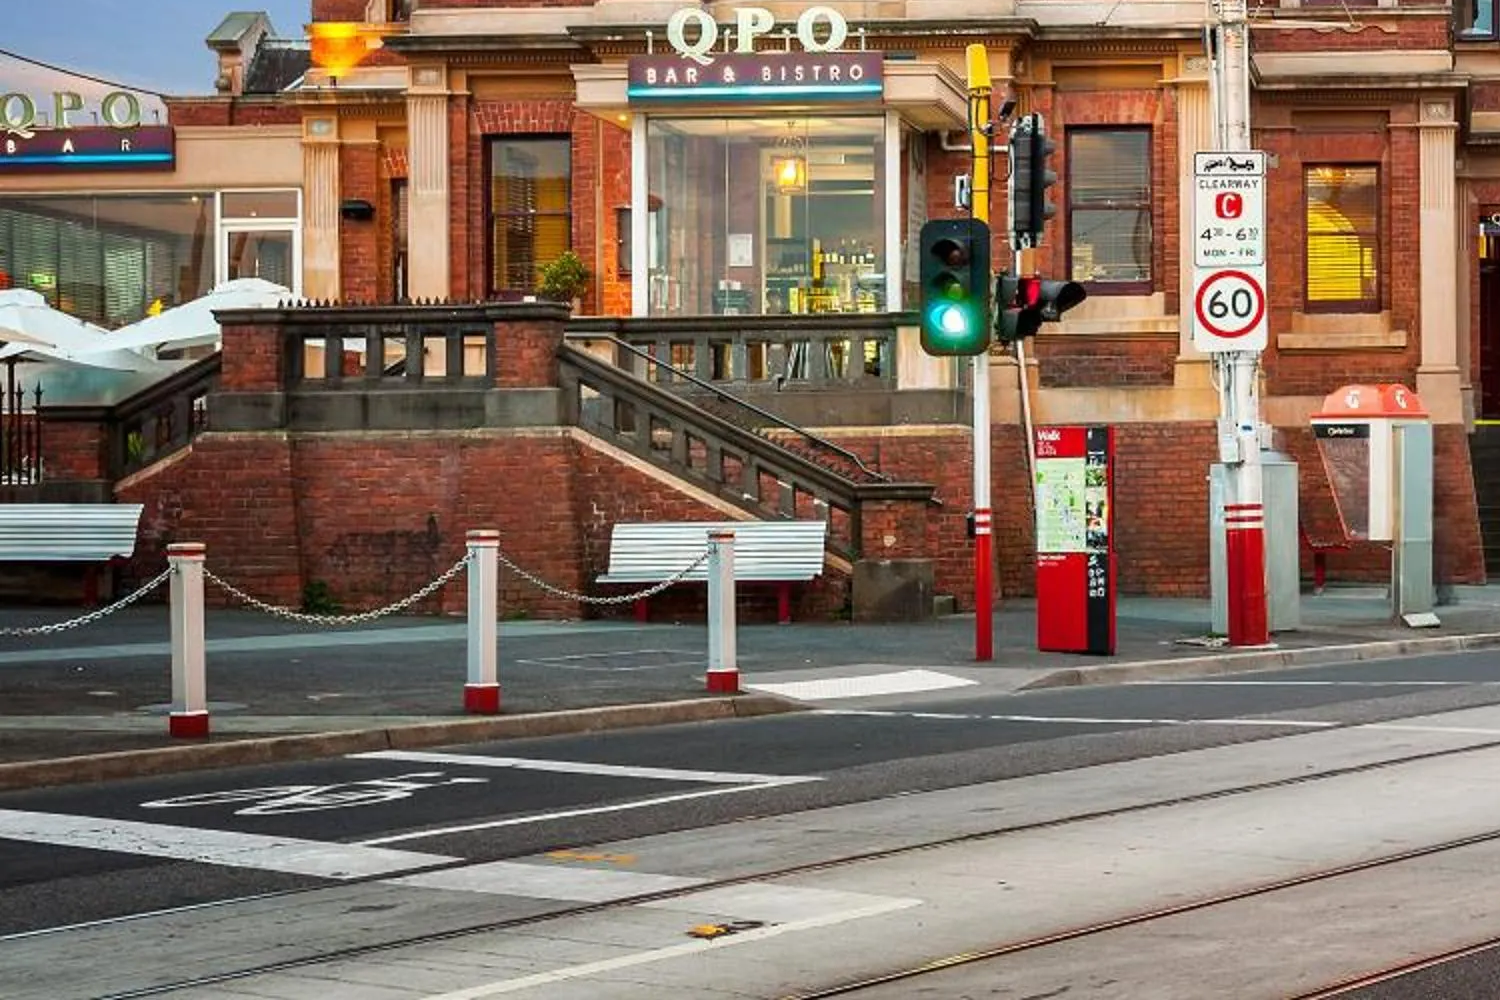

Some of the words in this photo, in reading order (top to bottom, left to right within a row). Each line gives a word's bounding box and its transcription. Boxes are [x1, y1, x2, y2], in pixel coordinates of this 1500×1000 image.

[667, 6, 849, 65] QPO
[646, 68, 698, 84] BAR
[723, 65, 736, 83] &
[762, 64, 864, 81] BISTRO
[0, 91, 141, 138] QPO
[1199, 179, 1259, 189] CLEARWAY
[1222, 193, 1237, 217] C
[1209, 287, 1253, 319] 60
